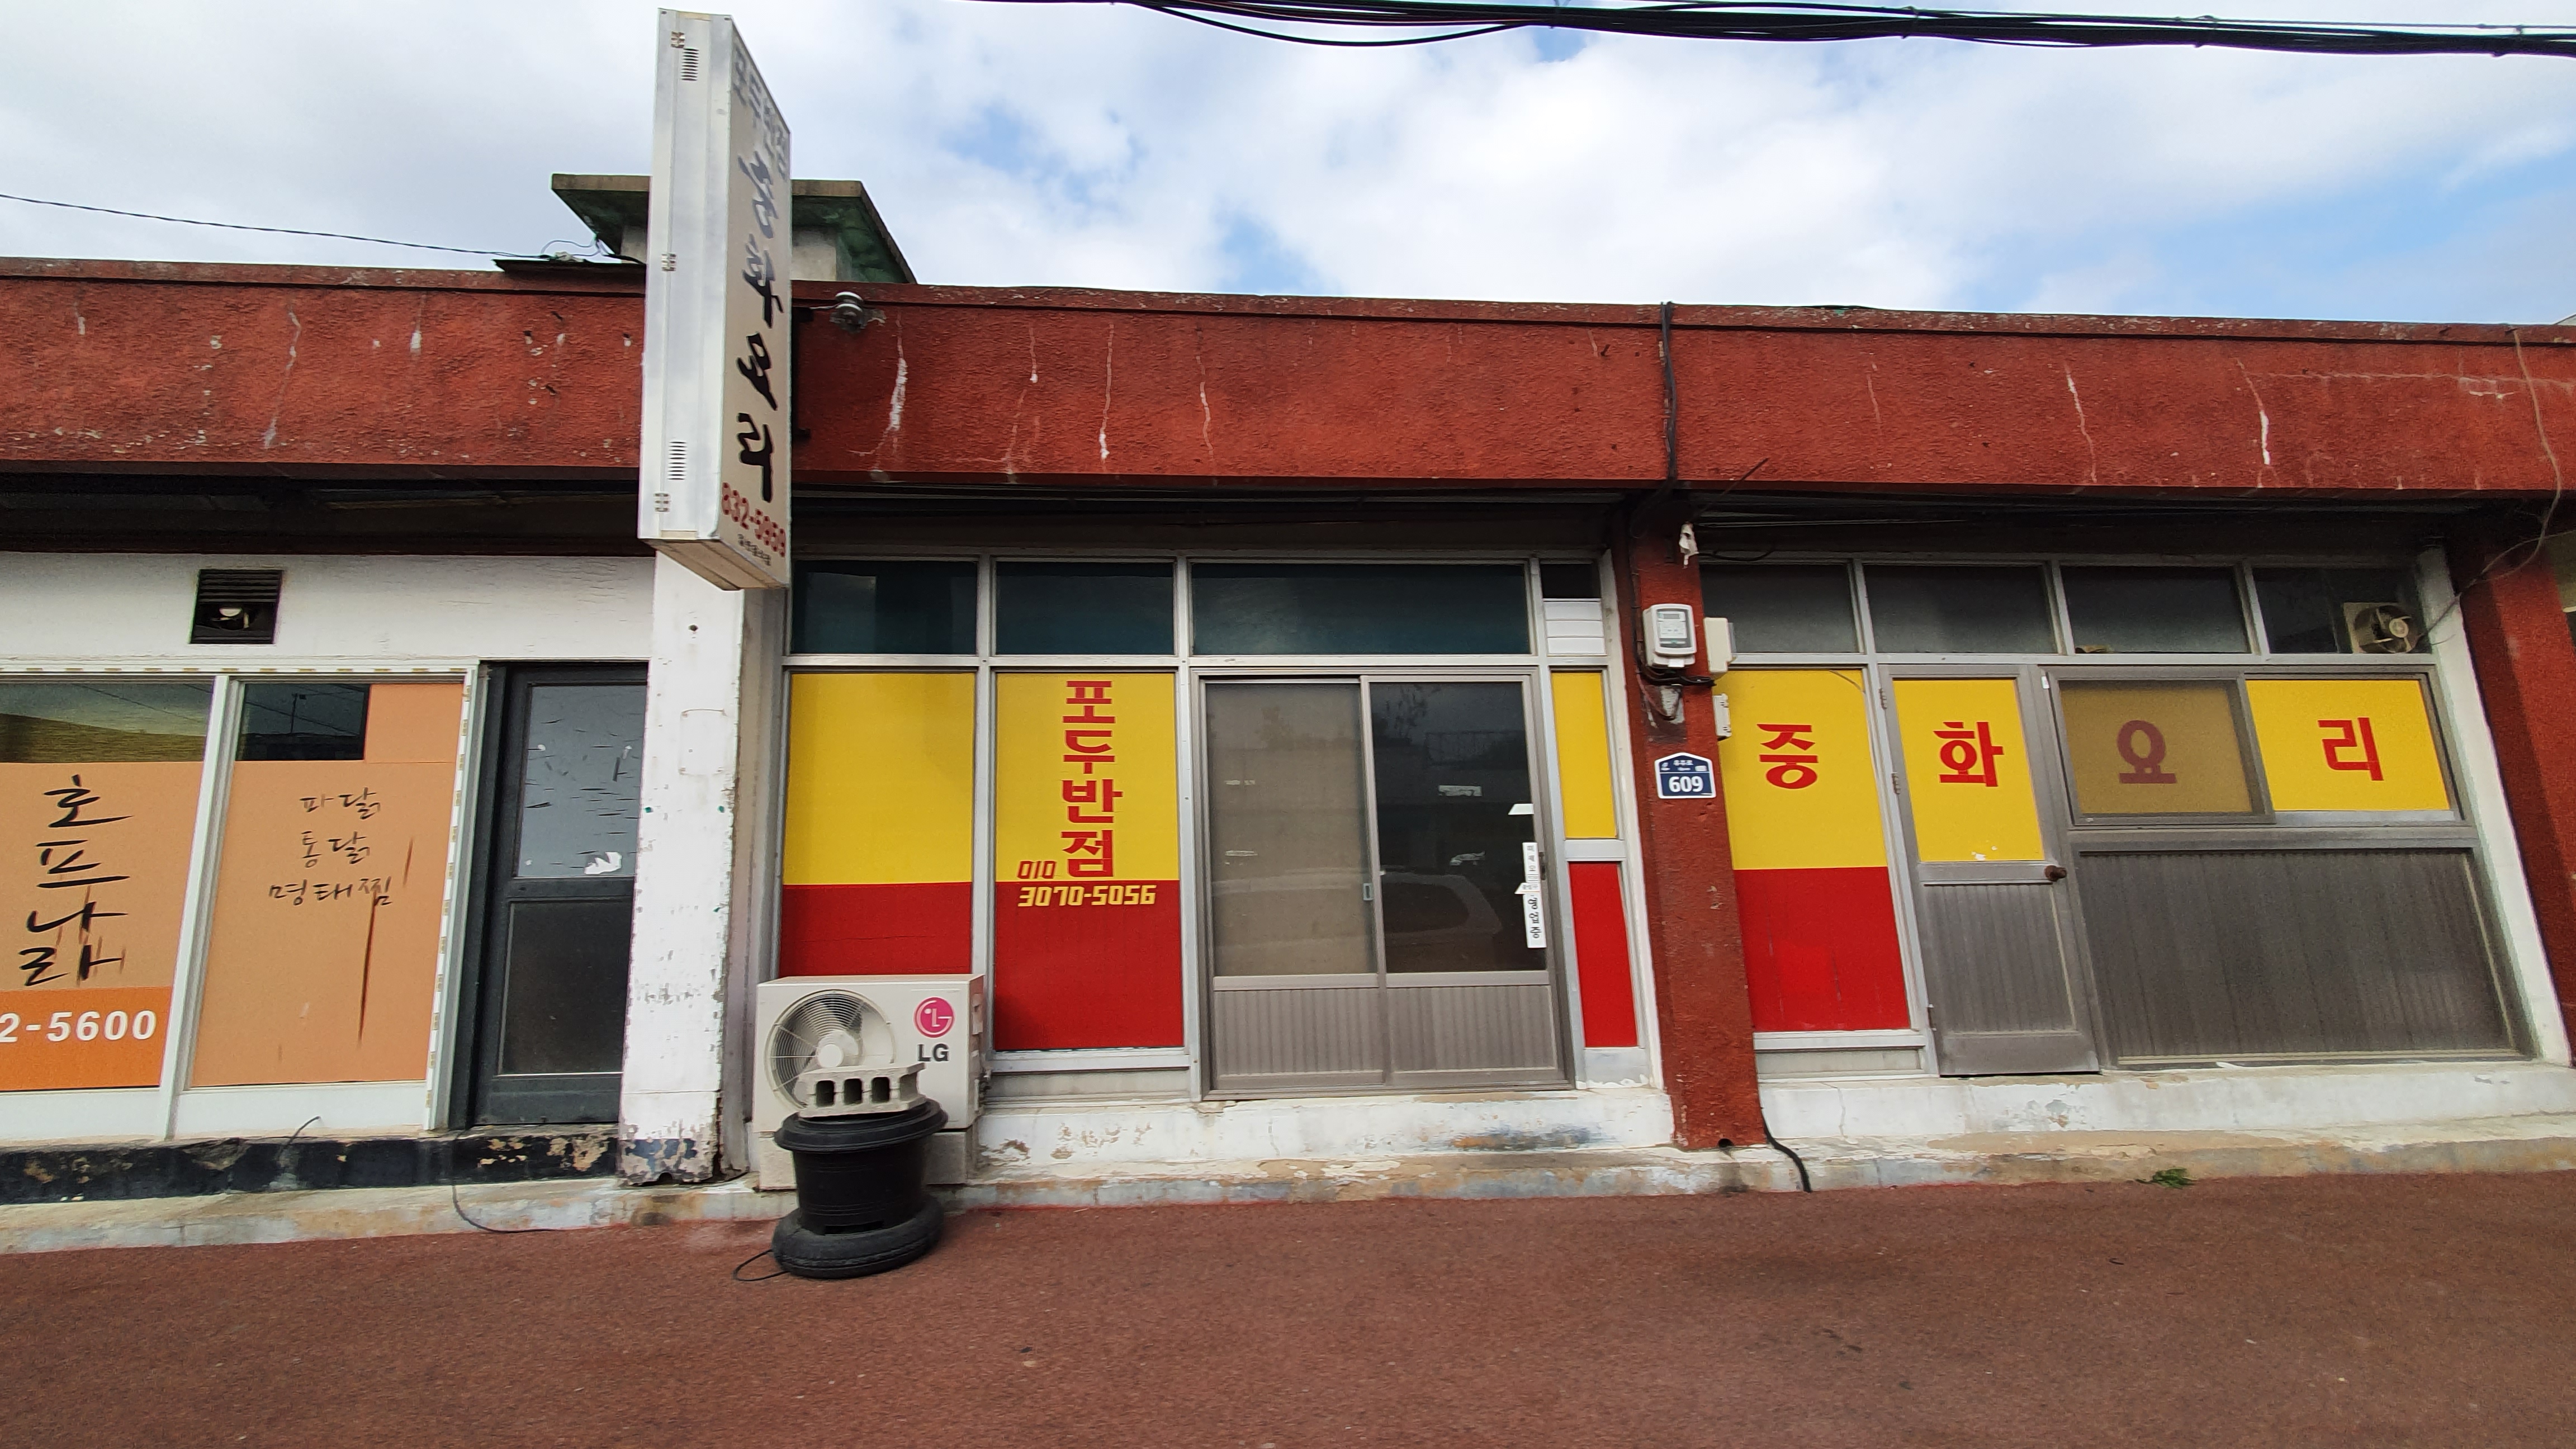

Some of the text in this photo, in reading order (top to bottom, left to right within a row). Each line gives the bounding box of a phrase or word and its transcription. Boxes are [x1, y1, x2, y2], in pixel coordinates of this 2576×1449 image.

[737, 150, 784, 502] 중화요리
[1756, 717, 2384, 790] 중 화 요 리
[1061, 680, 1123, 878] 포두반점
[1668, 775, 1704, 793] 609
[300, 787, 381, 820] 파닭
[301, 831, 370, 868] 통닭
[18, 774, 134, 987] 호프나라
[1017, 860, 1057, 879] 010
[269, 876, 392, 907] 명태찜
[1017, 884, 1157, 907] 3070-5056
[1527, 897, 1541, 939] 영업중
[0, 1010, 157, 1043] 2-5600
[916, 1043, 949, 1062] LG
